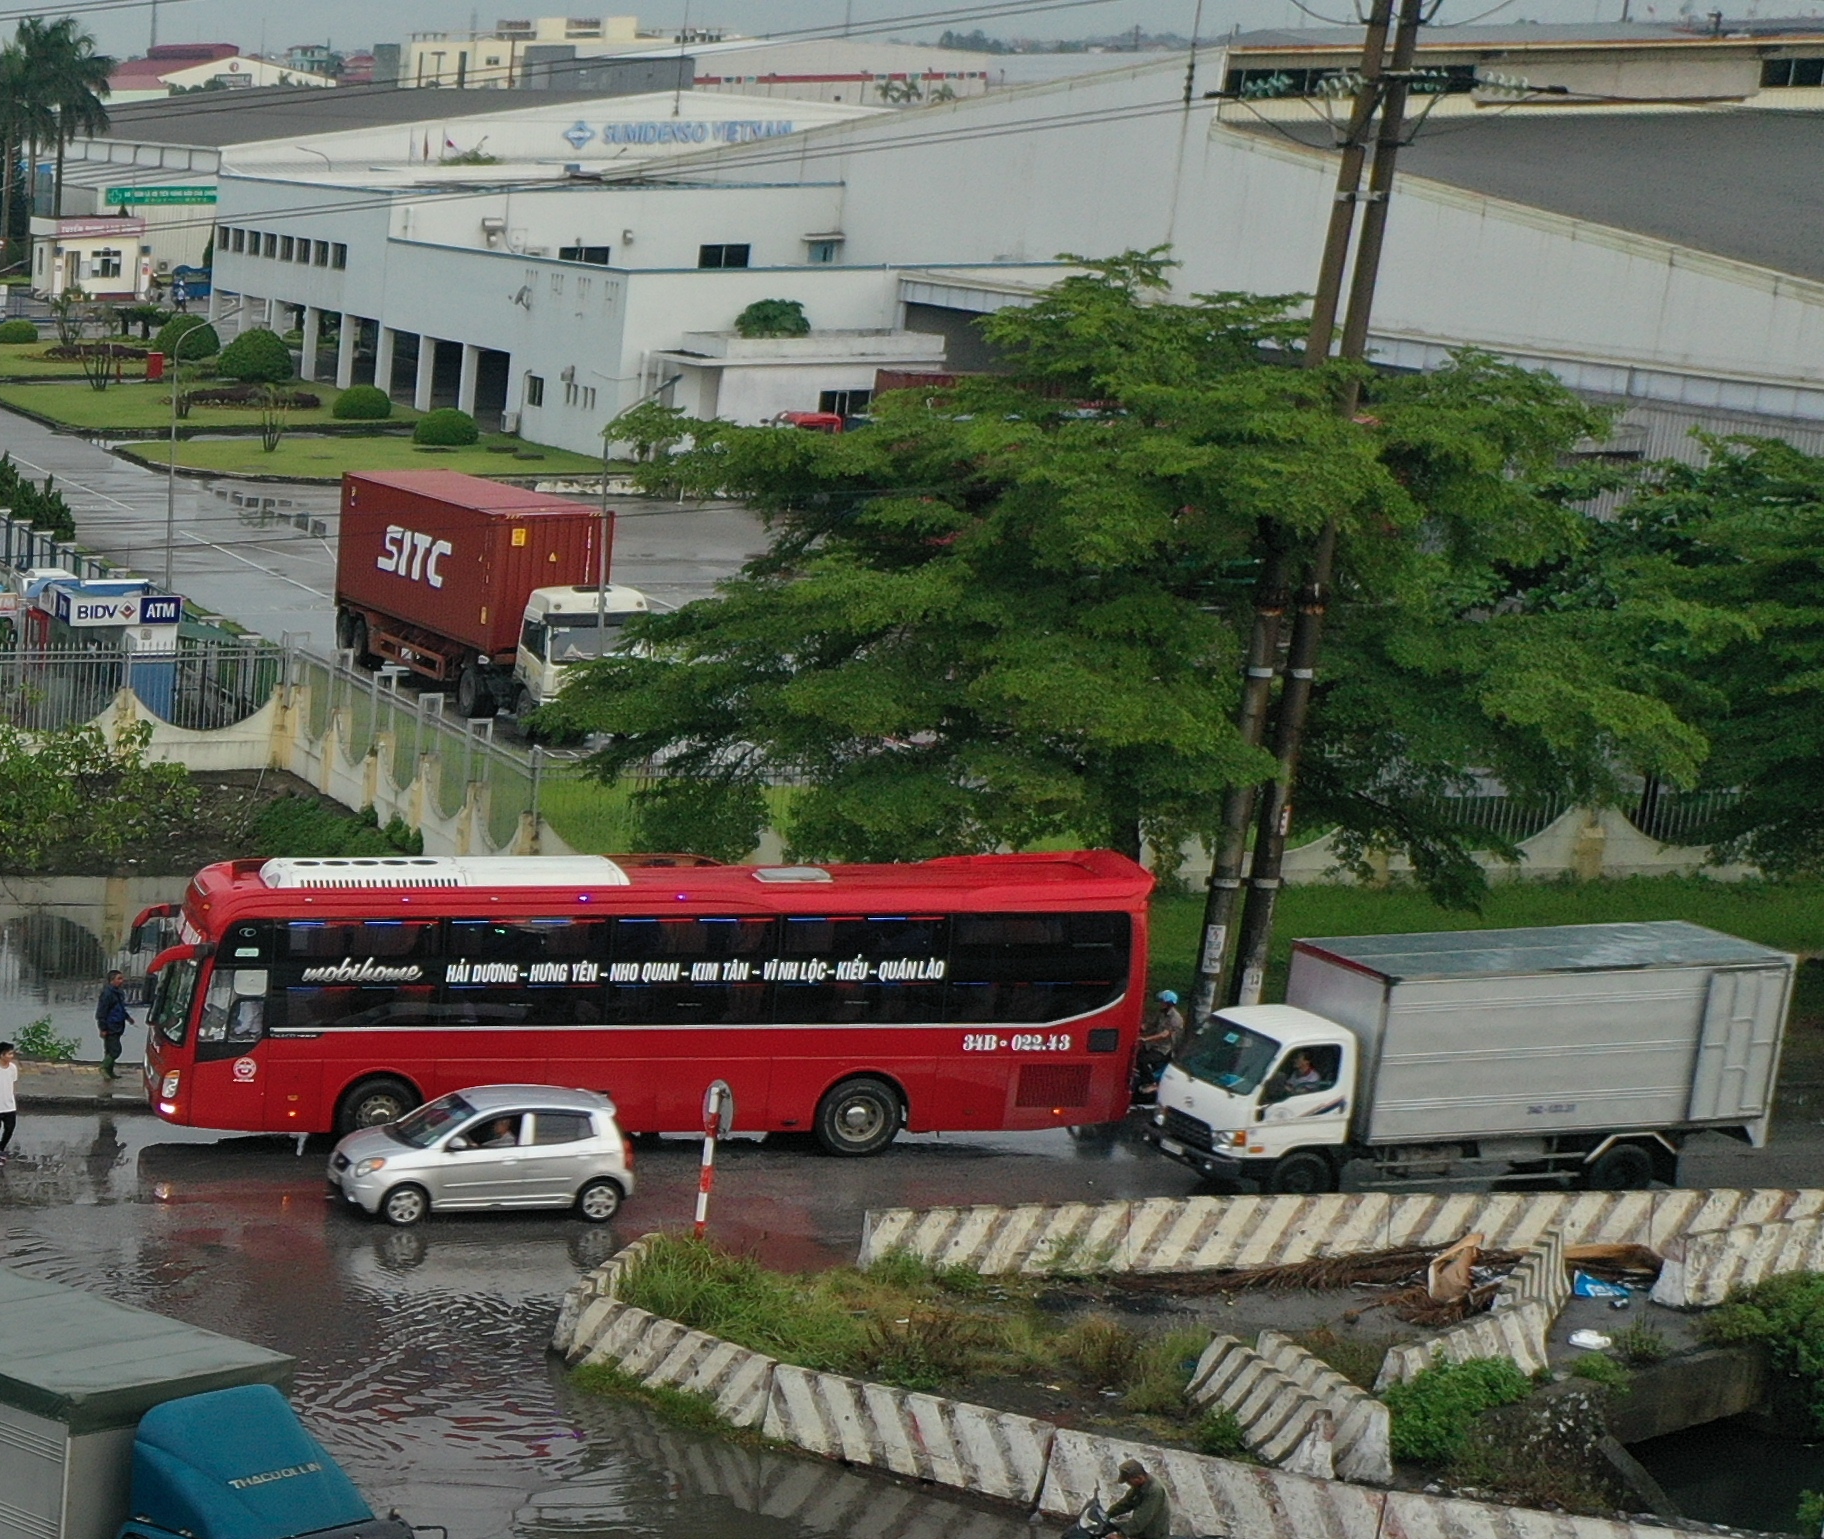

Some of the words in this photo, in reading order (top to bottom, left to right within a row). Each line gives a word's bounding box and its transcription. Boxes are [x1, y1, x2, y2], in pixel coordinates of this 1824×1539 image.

[603, 121, 707, 145] SUMIDENSO
[376, 524, 453, 589] SITC
[77, 604, 119, 620] BIDV
[146, 602, 176, 619] ATM
[301, 957, 423, 982] mobihome
[446, 958, 469, 983] HẢI
[472, 961, 519, 984] DƯƠNG
[529, 961, 568, 983] HƯNG
[571, 958, 598, 983] YÊN
[610, 962, 638, 982] NHO
[641, 962, 680, 984] QUAN
[691, 962, 720, 982] KIM
[722, 958, 749, 982] TÂN
[799, 957, 827, 984] LỘC
[878, 957, 918, 982] QUÁN
[917, 957, 945, 980] LÀO
[963, 1033, 997, 1051] 34B
[1011, 1033, 1071, 1052] 022.43
[228, 1469, 282, 1490] THACO
